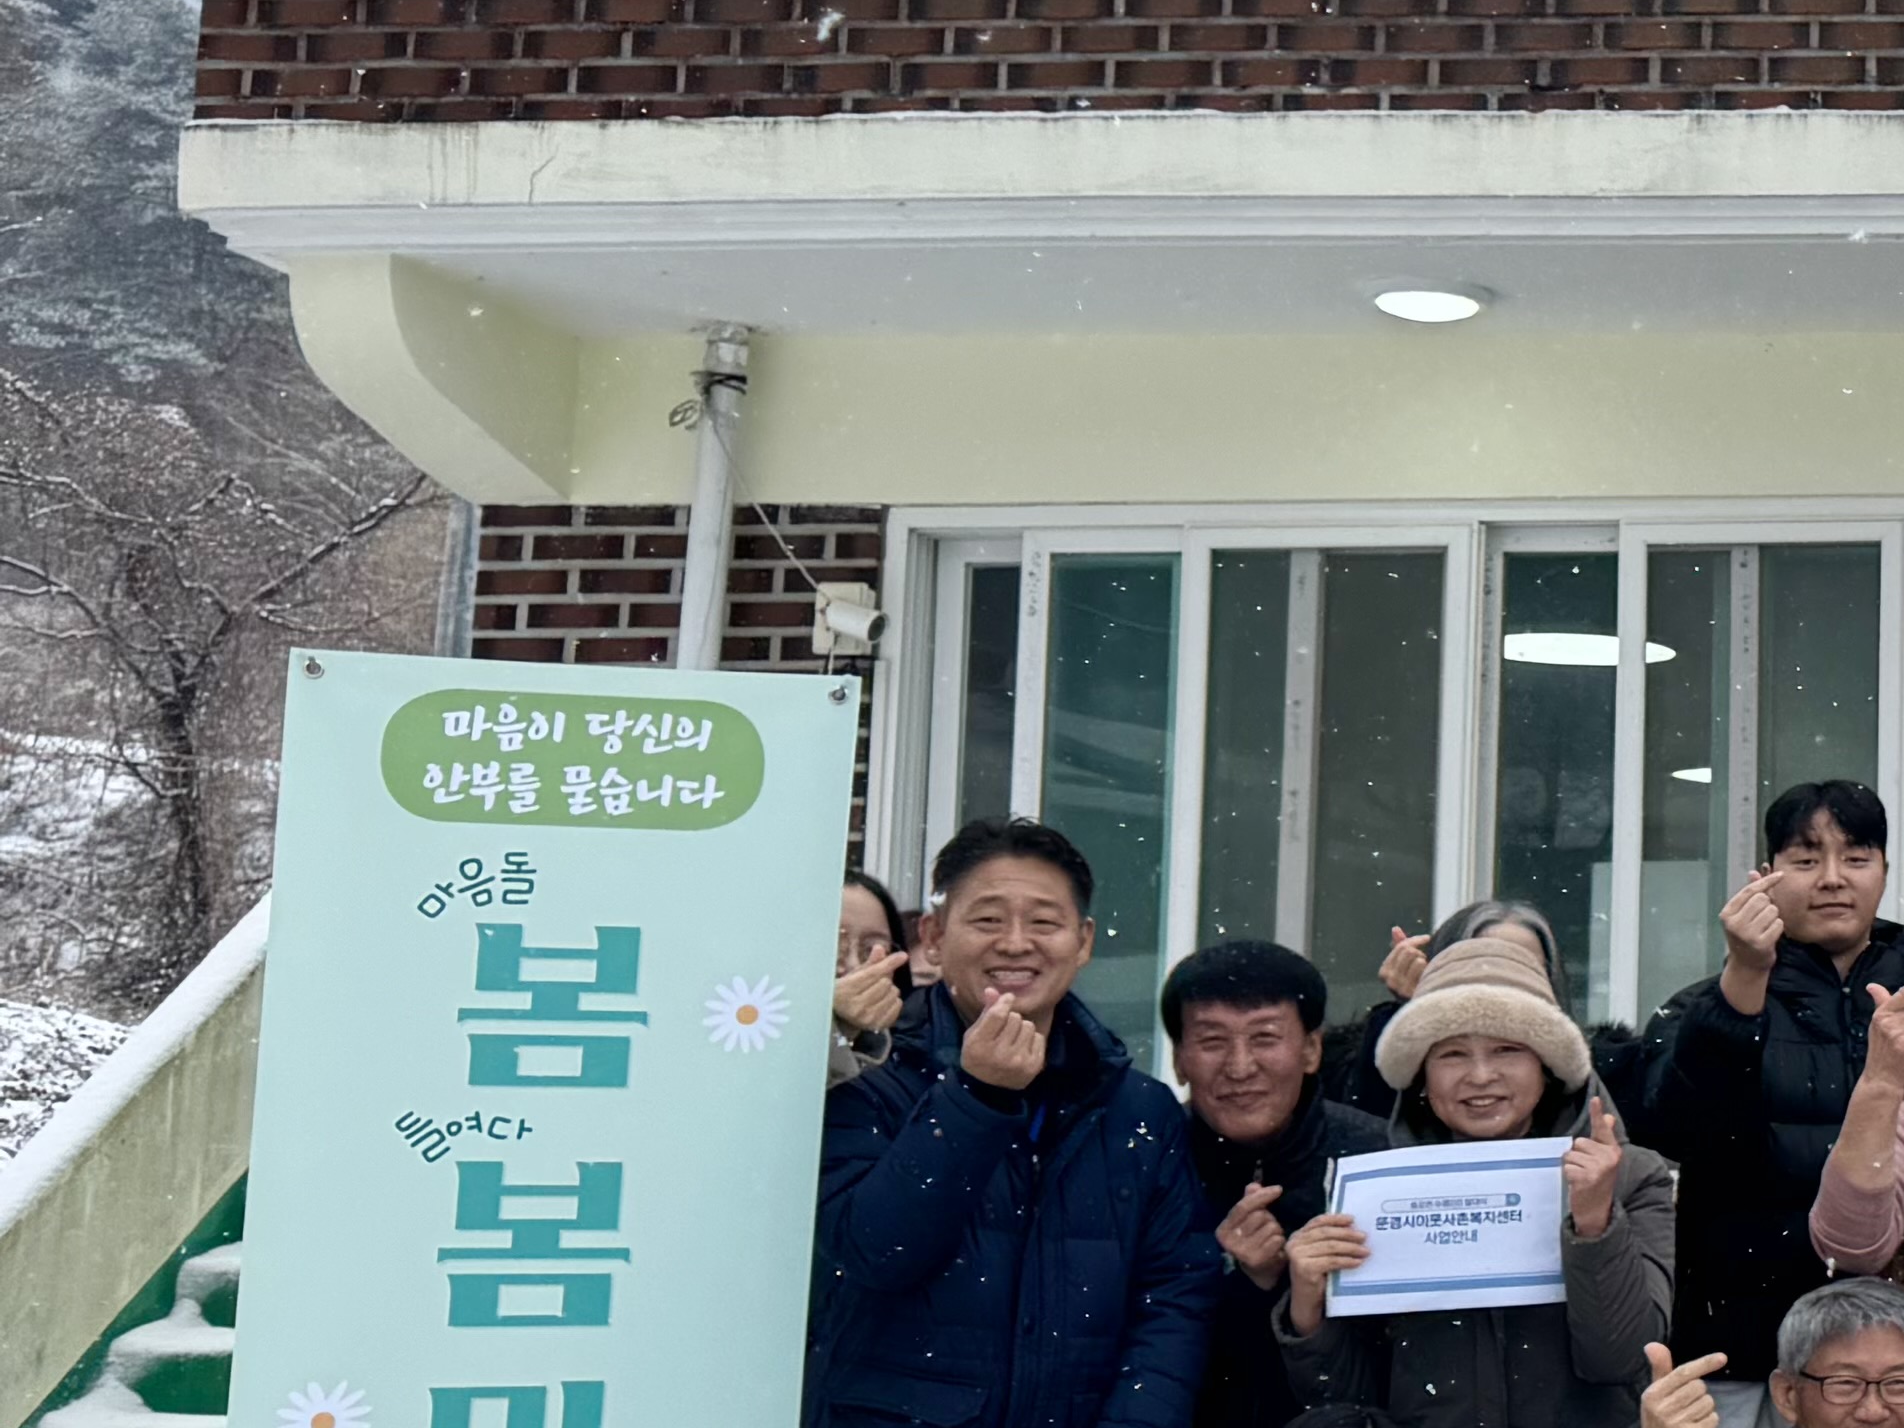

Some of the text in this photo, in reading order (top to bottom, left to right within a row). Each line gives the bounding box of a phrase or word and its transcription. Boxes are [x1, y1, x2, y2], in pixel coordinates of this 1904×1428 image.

[442, 703, 712, 754] 마음이 당신의
[423, 761, 541, 814] 안부를
[395, 1111, 533, 1163] 들여다
